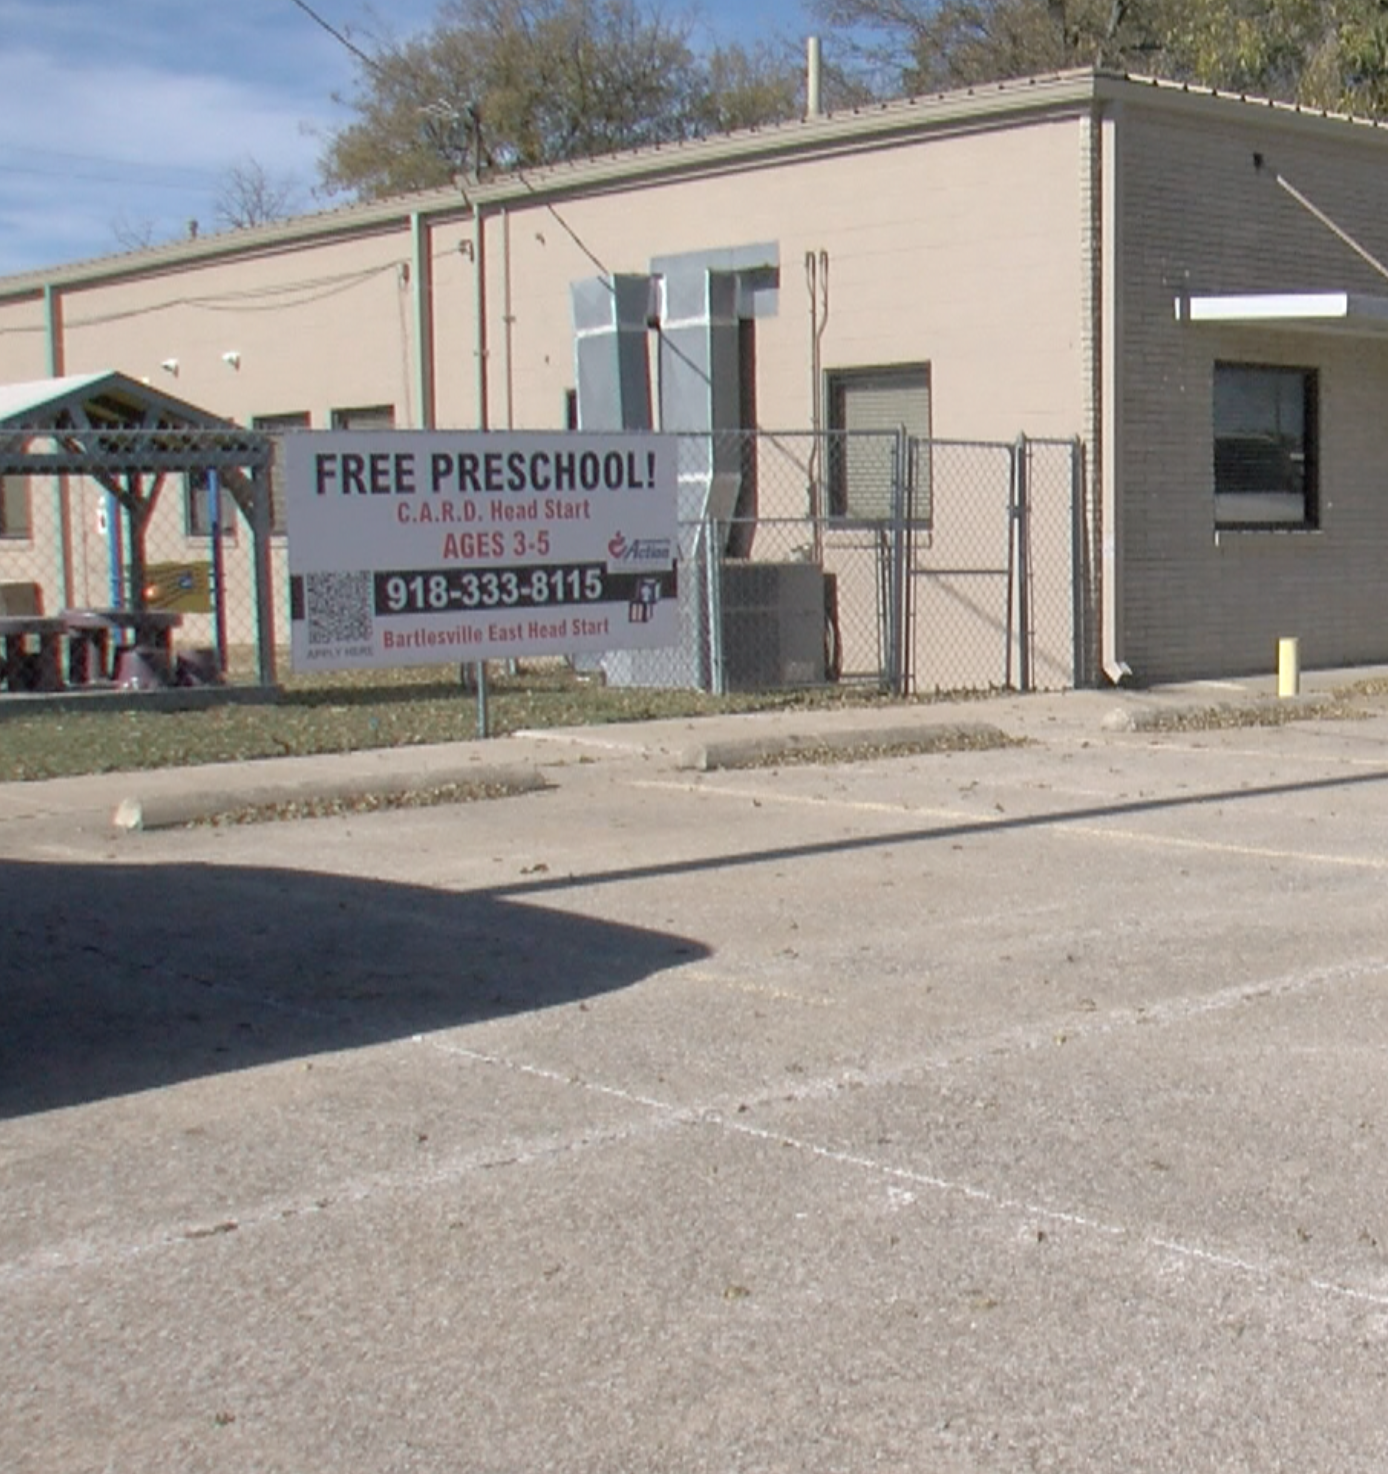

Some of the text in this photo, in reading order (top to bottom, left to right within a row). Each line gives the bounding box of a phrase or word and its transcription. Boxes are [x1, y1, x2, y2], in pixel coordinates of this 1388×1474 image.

[315, 451, 655, 494] FREE PRESCHOOL!
[397, 499, 590, 523] C.A.R.D. Head Start
[443, 530, 550, 558] AGES 3-5
[624, 539, 671, 560] Action
[386, 569, 602, 610] 918-333-8115
[383, 618, 609, 648] Bartlesville East Head Start
[306, 645, 374, 660] APPLY HERE
